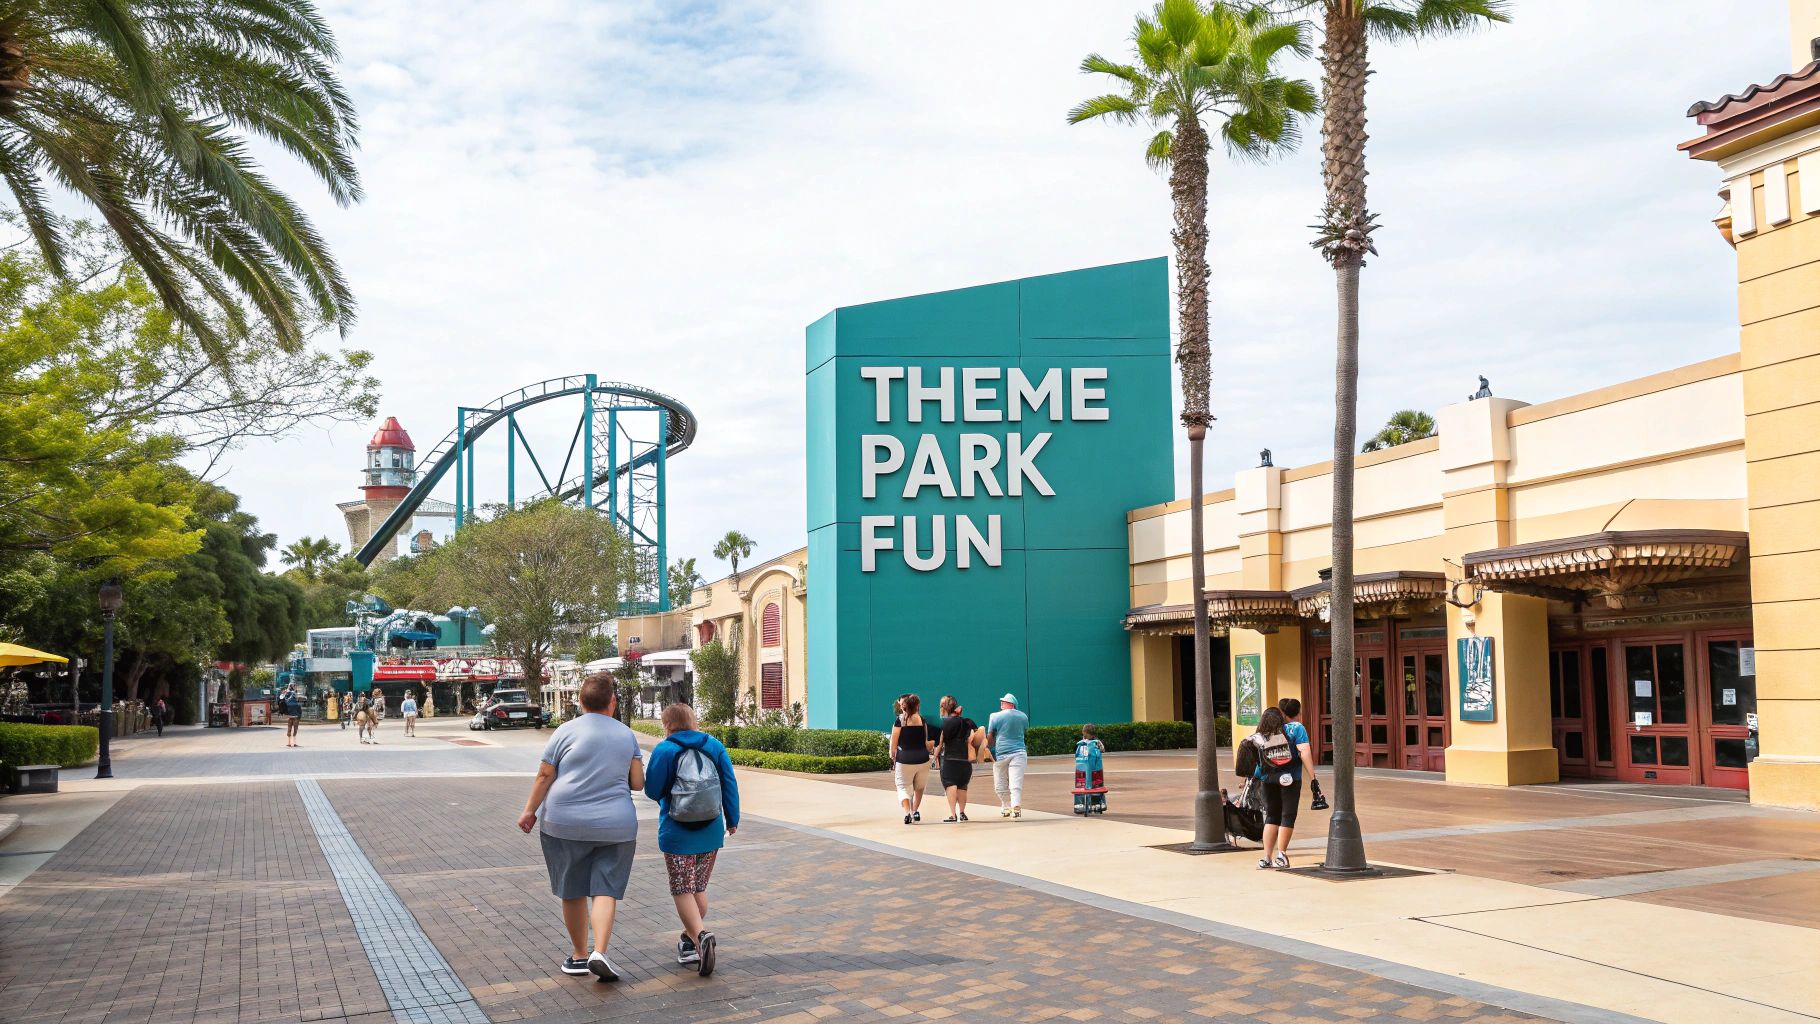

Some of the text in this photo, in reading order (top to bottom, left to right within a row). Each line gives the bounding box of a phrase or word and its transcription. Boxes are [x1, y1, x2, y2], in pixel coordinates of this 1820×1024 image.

[860, 366, 1110, 422] THEME
[861, 432, 1057, 498] PARK
[860, 514, 1002, 572] FUN
